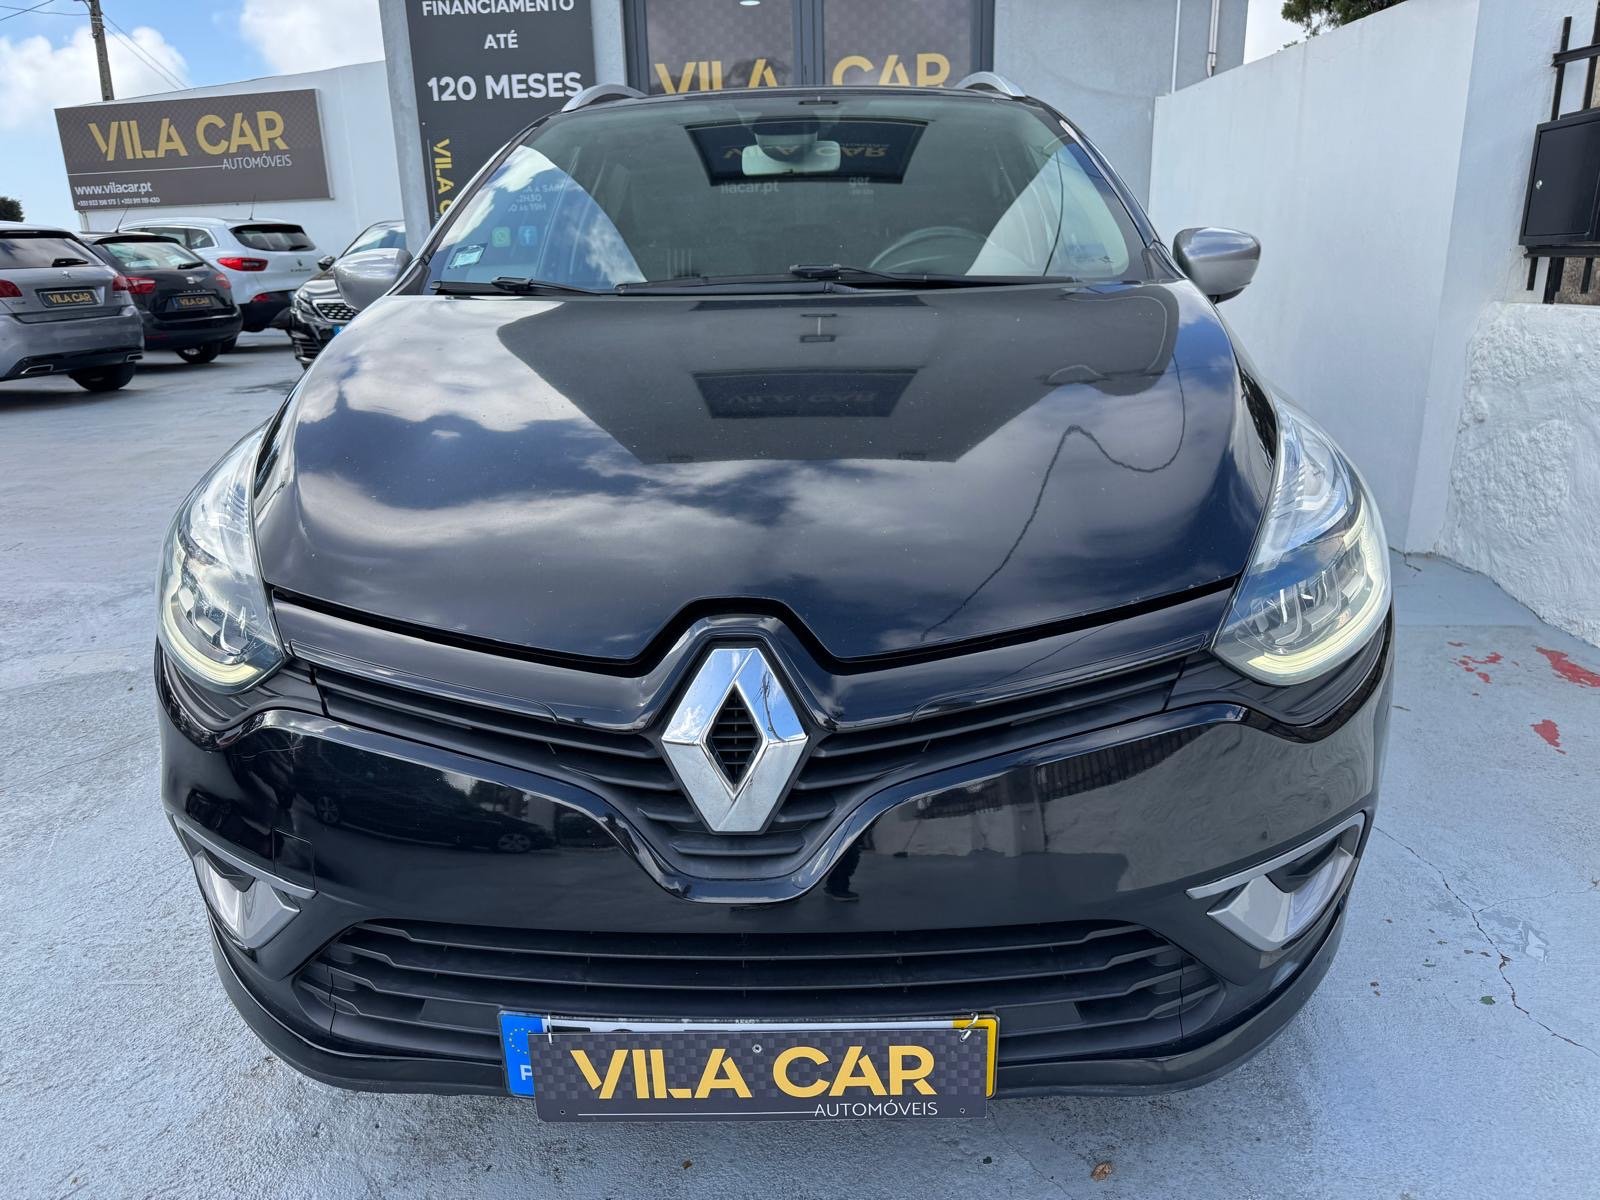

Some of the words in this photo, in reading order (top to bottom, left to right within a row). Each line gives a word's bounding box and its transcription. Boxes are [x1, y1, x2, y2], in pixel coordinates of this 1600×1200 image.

[422, 0, 575, 16] FINANCIAMENTO
[484, 30, 519, 49] ATÉ
[427, 75, 477, 102] 120
[485, 71, 583, 100] MESES
[88, 117, 188, 161] VILA
[195, 110, 290, 155] CAR
[222, 153, 292, 171] AUTOMÓVEIS
[433, 138, 455, 195] VILA
[74, 180, 152, 196] www.vilacar.pt
[570, 1049, 753, 1100] VILA
[772, 1045, 938, 1098] CAR
[814, 1099, 938, 1117] AUTOMÓVEIS
